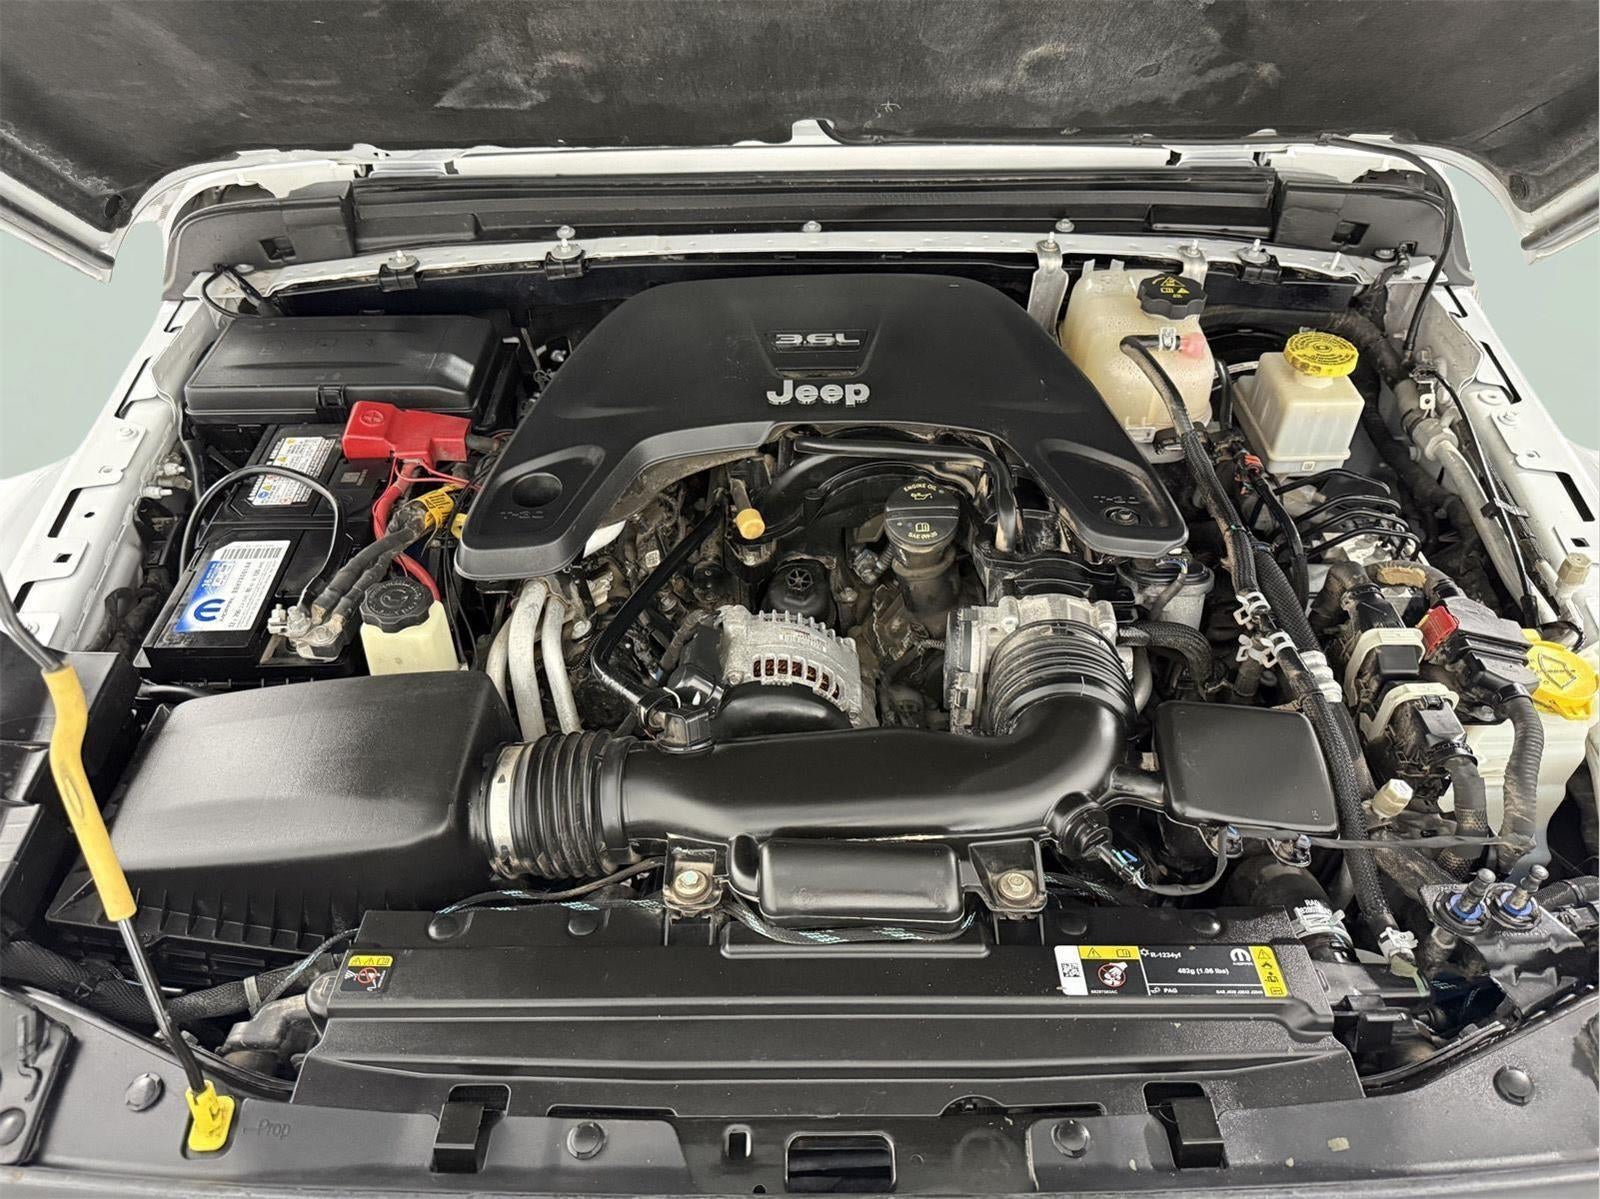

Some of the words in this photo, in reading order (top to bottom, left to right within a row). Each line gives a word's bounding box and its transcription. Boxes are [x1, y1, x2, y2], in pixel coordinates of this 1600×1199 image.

[775, 333, 860, 347] 3.6L
[766, 379, 870, 407] Jeep
[903, 483, 926, 493] ENGINE
[927, 483, 938, 492] OIL
[907, 531, 920, 539] SAE
[1150, 951, 1182, 960] R-1234yf
[257, 1119, 291, 1140] Prop
